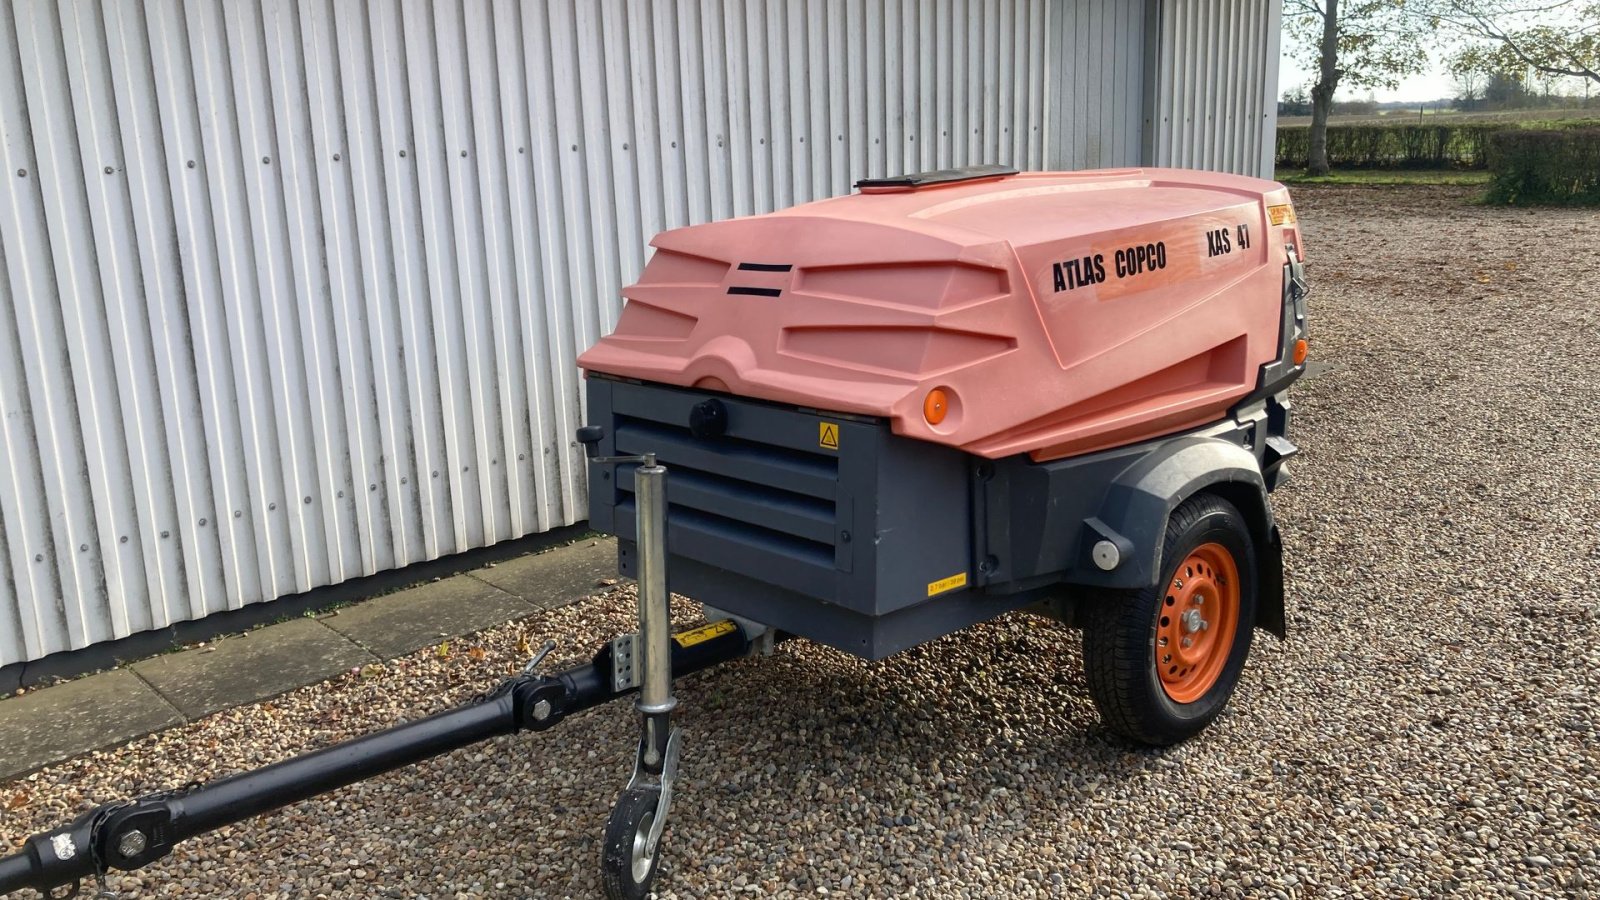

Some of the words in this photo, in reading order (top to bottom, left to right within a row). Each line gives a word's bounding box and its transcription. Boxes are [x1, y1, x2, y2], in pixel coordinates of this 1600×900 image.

[1206, 227, 1231, 258] XAS
[1237, 223, 1250, 250] 47
[1053, 254, 1106, 293] ATLAS
[1115, 241, 1167, 279] COPCO
